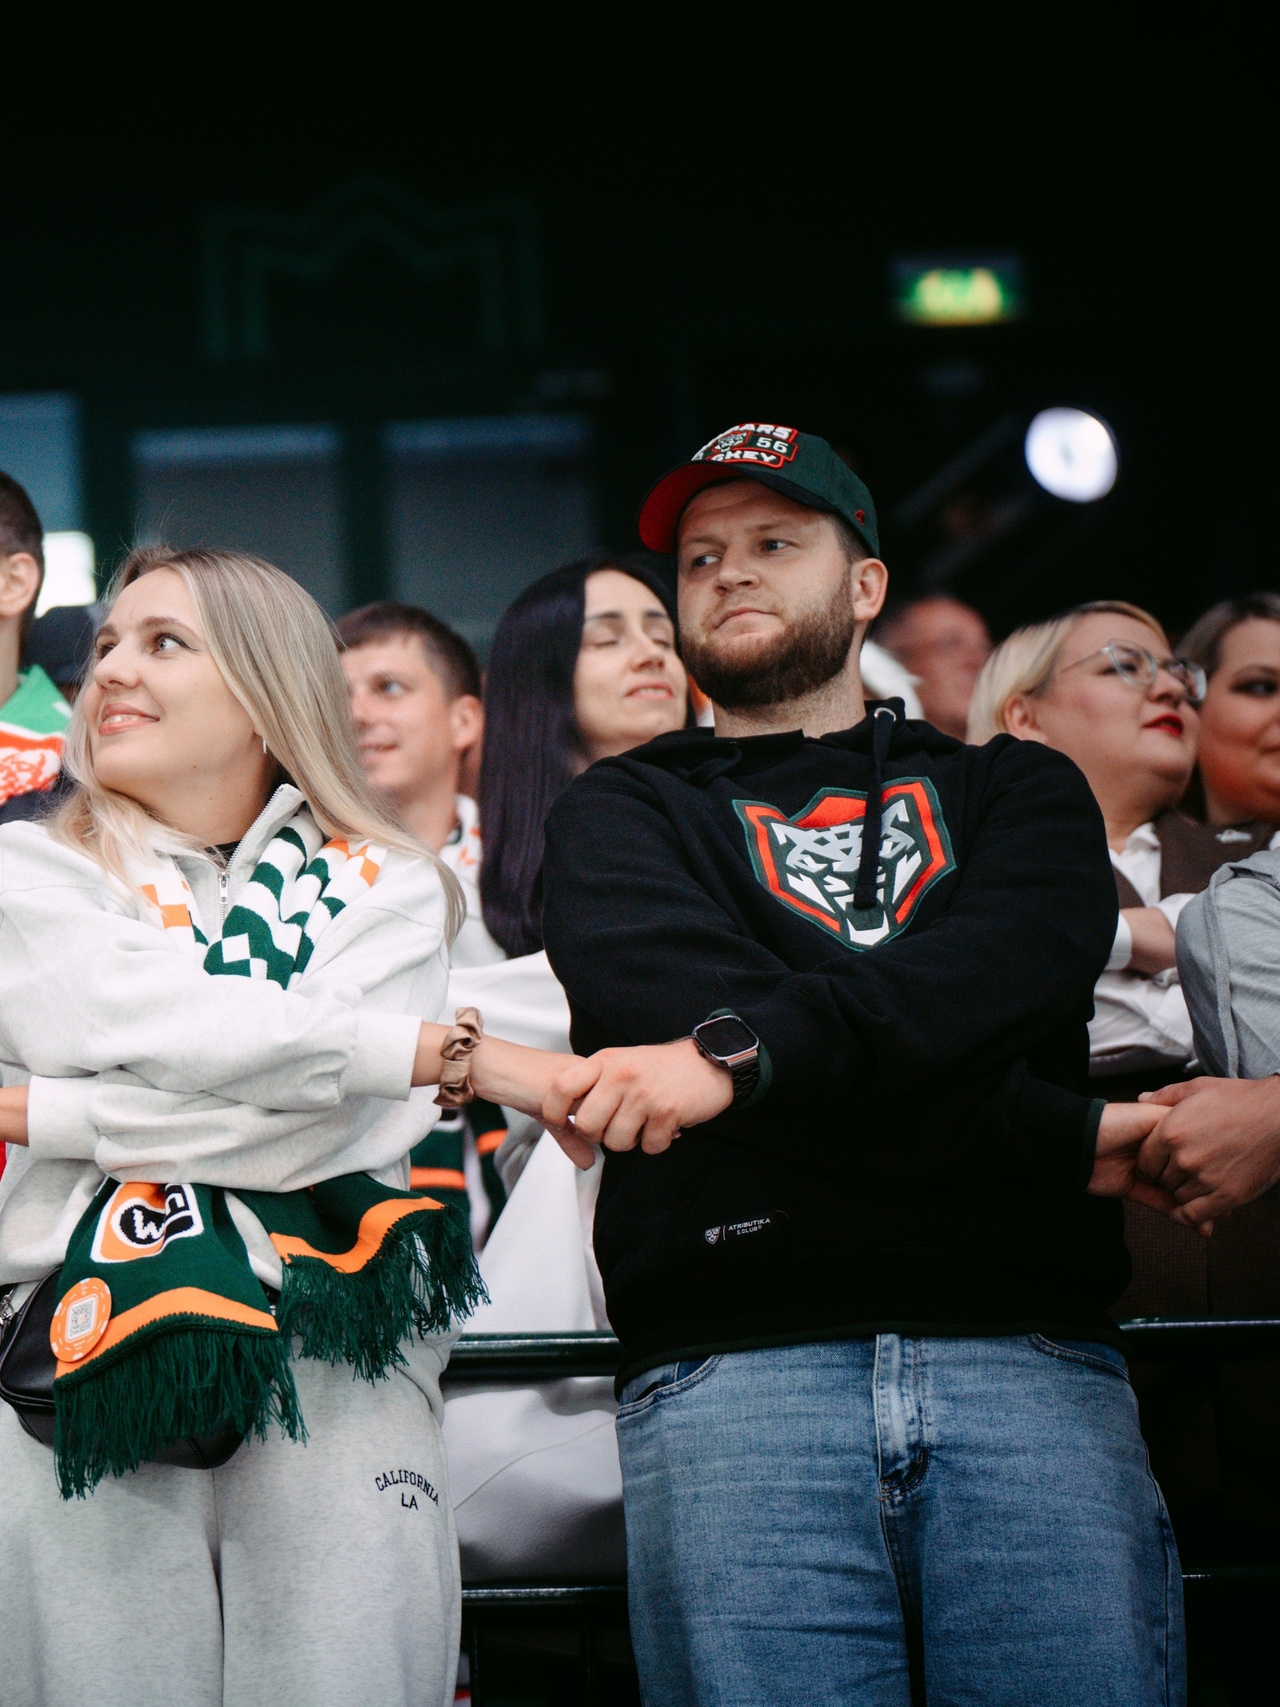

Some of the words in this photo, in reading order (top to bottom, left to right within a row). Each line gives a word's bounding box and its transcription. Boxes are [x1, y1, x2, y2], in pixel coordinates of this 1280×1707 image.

[756, 437, 789, 454] 56
[728, 1218, 771, 1231] ATRIBUTIKA
[375, 1469, 439, 1507] CALIFORNIA
[401, 1492, 419, 1510] LA
